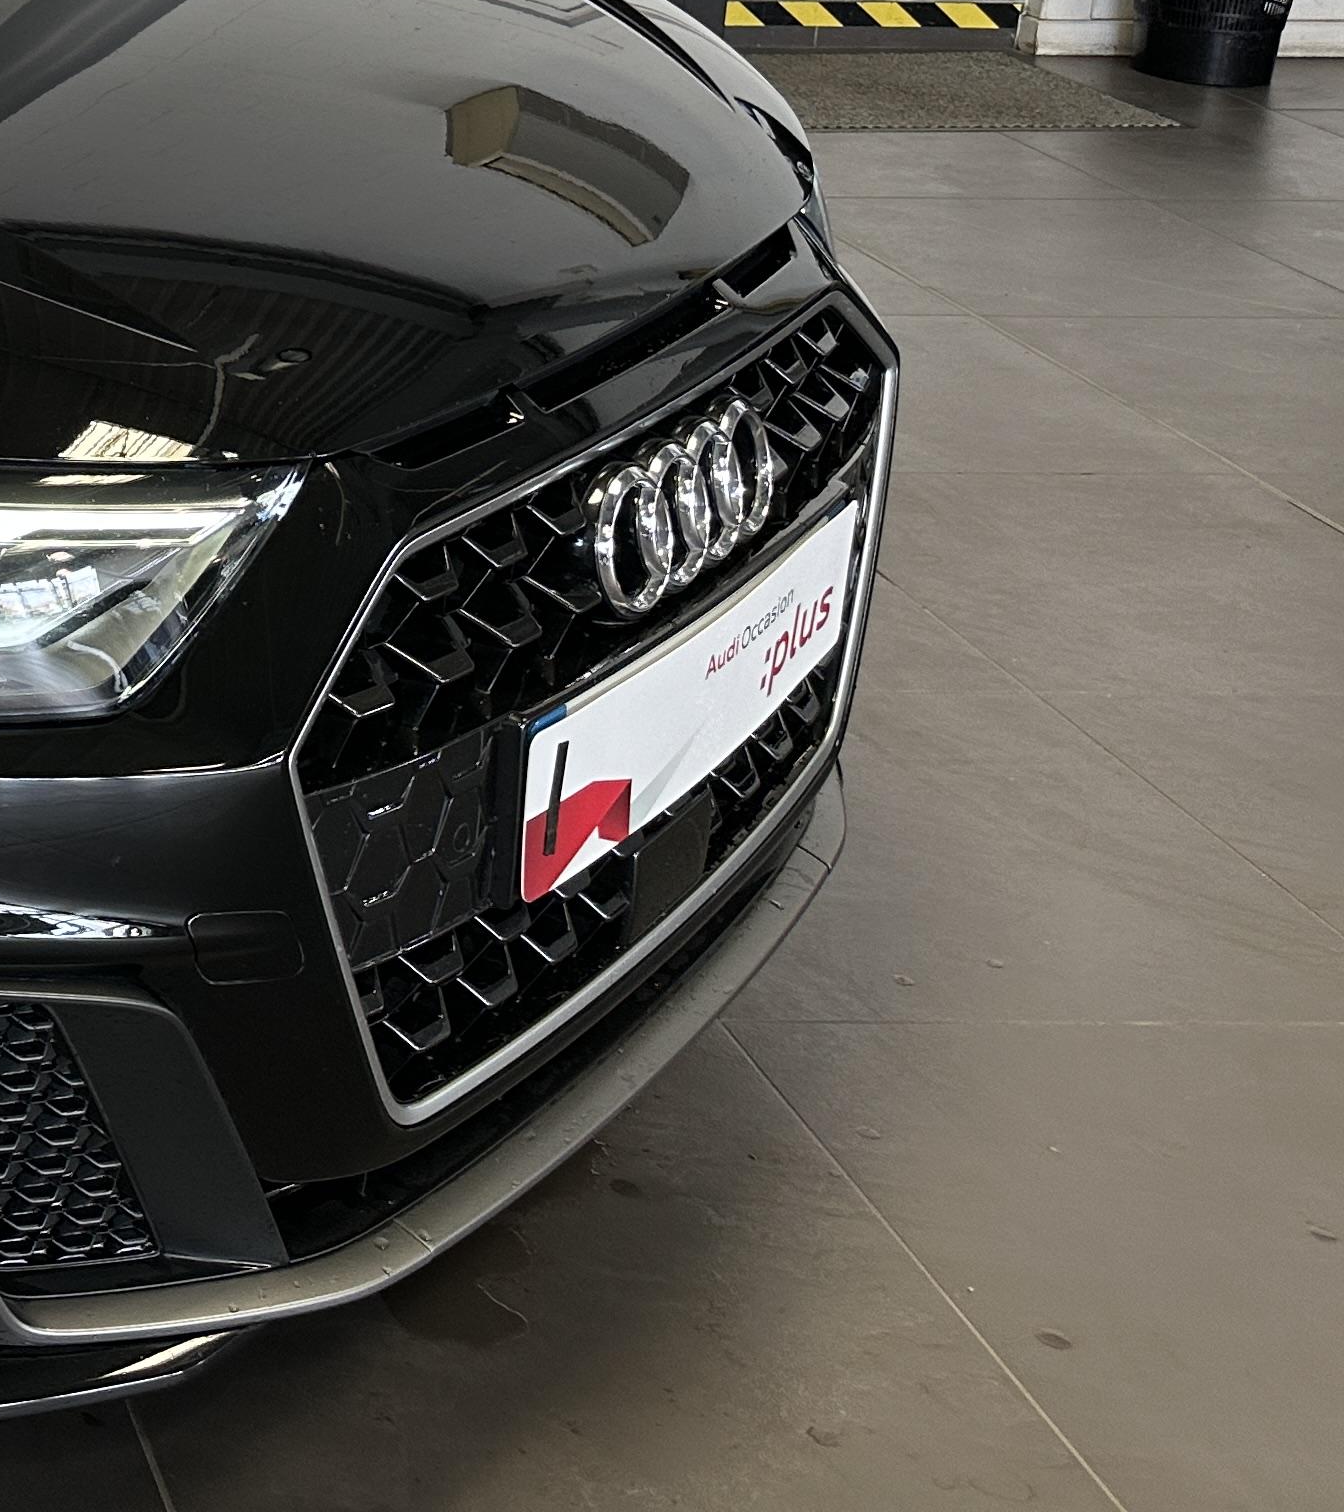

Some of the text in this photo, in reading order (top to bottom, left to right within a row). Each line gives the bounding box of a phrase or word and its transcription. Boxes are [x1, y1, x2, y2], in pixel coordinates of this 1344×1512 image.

[705, 586, 795, 680] Audi Occasion
[759, 585, 834, 698] :plus
